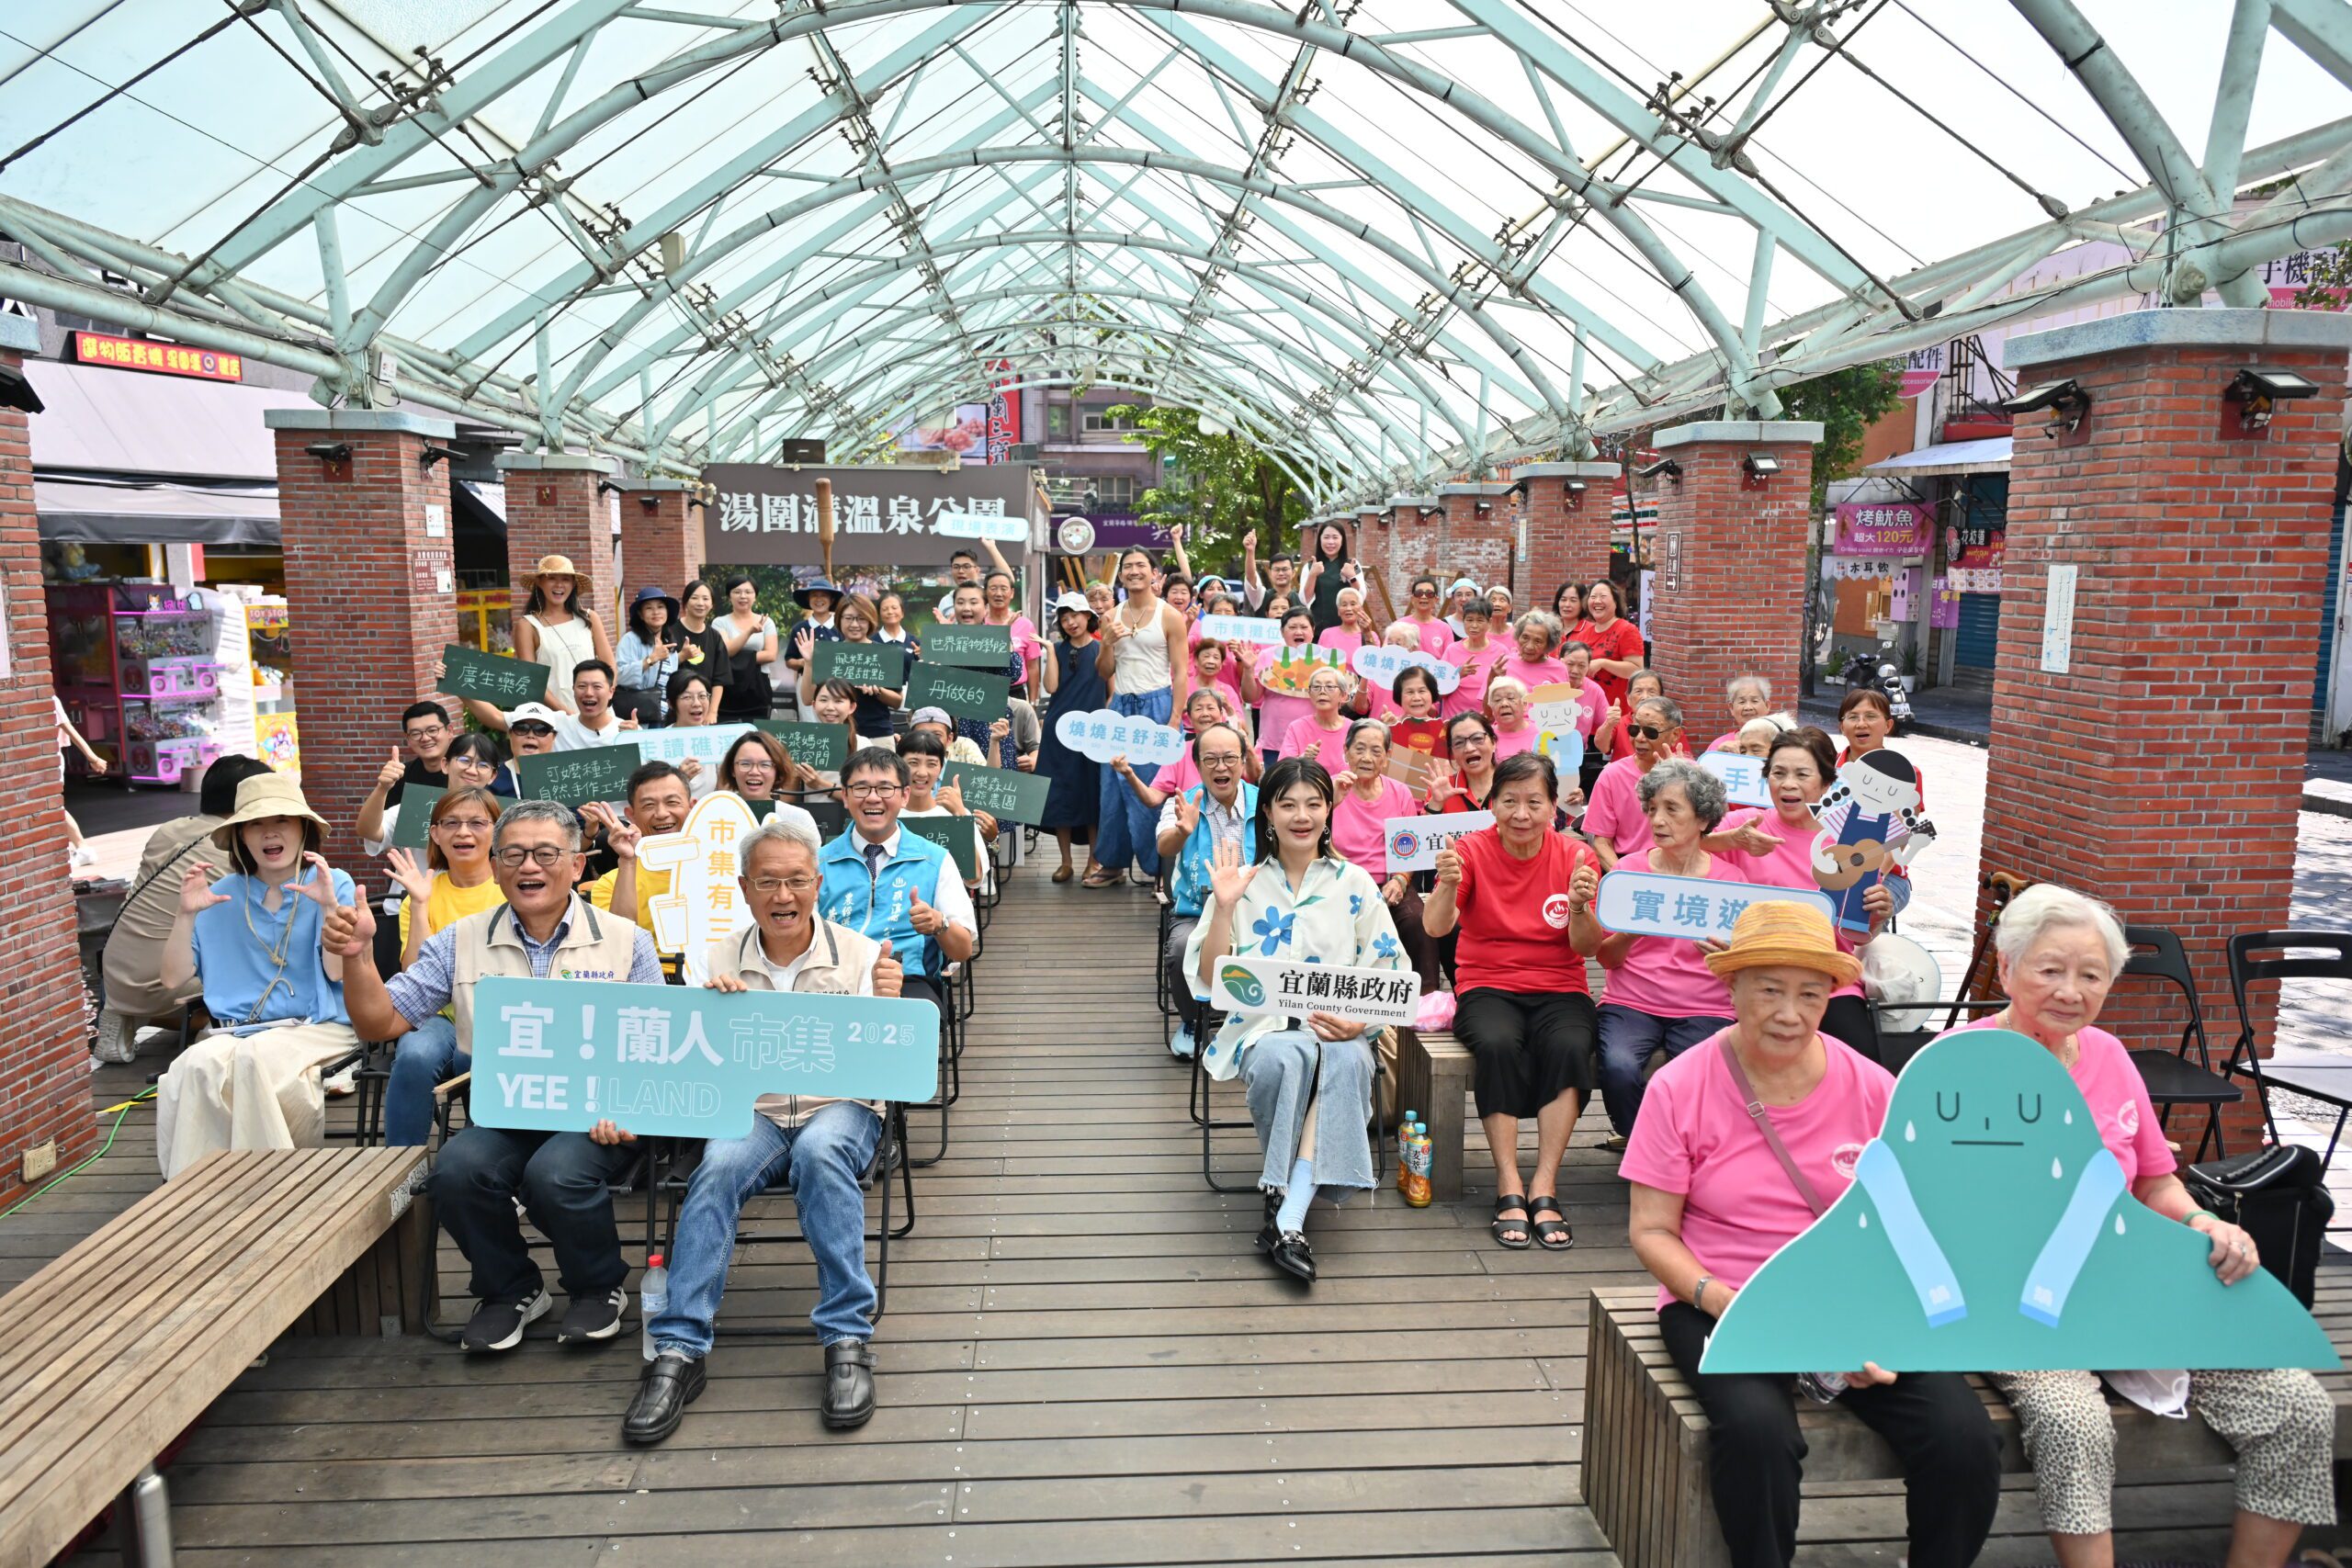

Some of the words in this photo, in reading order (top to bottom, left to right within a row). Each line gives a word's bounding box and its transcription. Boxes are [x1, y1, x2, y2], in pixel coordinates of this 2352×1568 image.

[950, 518, 1016, 536] 現場表演
[1856, 510, 1913, 526] 烤魷魚
[1854, 530, 1914, 543] 超大120元
[1961, 529, 1985, 546] 花枝道
[1850, 562, 1889, 573] 木耳飲
[249, 609, 266, 617] TOY
[1214, 621, 1281, 640] 市集攤位
[931, 636, 1008, 653] 世界寵物學院
[458, 662, 531, 696] 廣生藥房
[831, 666, 885, 681] 老屋甜點
[929, 680, 986, 705] 丹做的
[539, 777, 628, 801] 自然手作工坊
[963, 790, 1017, 810] 生態農園
[706, 818, 737, 943] 市集有三
[574, 970, 615, 979] 宜蘭縣政府
[1278, 969, 1413, 1005] 宜蘭縣政府
[1278, 998, 1304, 1010] Yilan
[1306, 1002, 1342, 1013] County
[1344, 1005, 1407, 1018] Government
[847, 1021, 916, 1046] 2025
